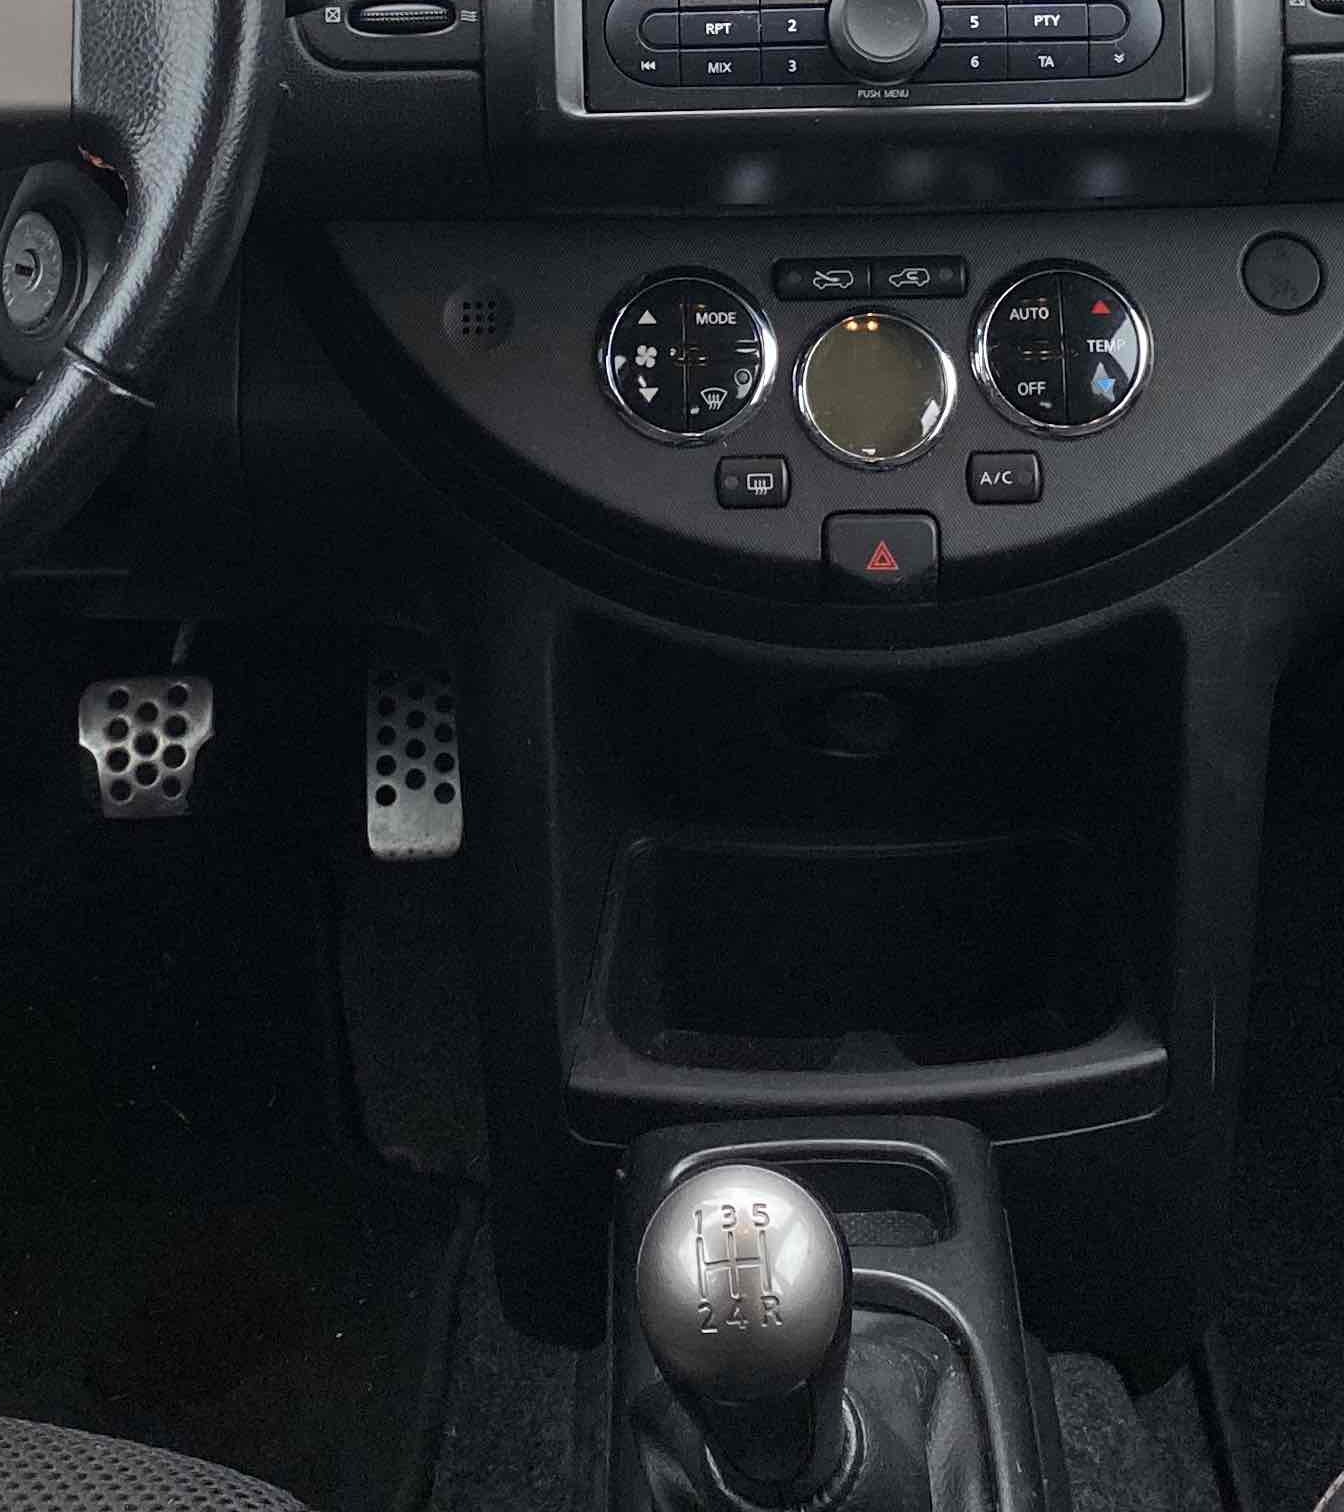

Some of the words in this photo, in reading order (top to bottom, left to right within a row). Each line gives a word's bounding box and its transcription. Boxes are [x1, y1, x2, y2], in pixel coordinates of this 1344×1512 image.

[787, 19, 797, 32] 2
[969, 16, 979, 29] 5
[1034, 15, 1061, 27] PTY
[705, 22, 732, 35] RPT
[708, 61, 732, 74] MIX
[787, 60, 797, 72] 3
[970, 56, 979, 68] 6
[1038, 56, 1055, 68] TA
[858, 89, 880, 98] PUSH
[884, 89, 909, 98] MENU
[696, 312, 736, 325] MODE
[1009, 307, 1049, 320] AUTO
[1087, 339, 1126, 352] TEMP
[1017, 382, 1046, 396] OFF
[980, 471, 1013, 485] A/C
[693, 1208, 703, 1237] 1
[720, 1204, 737, 1230] 3
[752, 1203, 770, 1228] 5
[696, 1301, 718, 1334] 2
[760, 1294, 783, 1327] R
